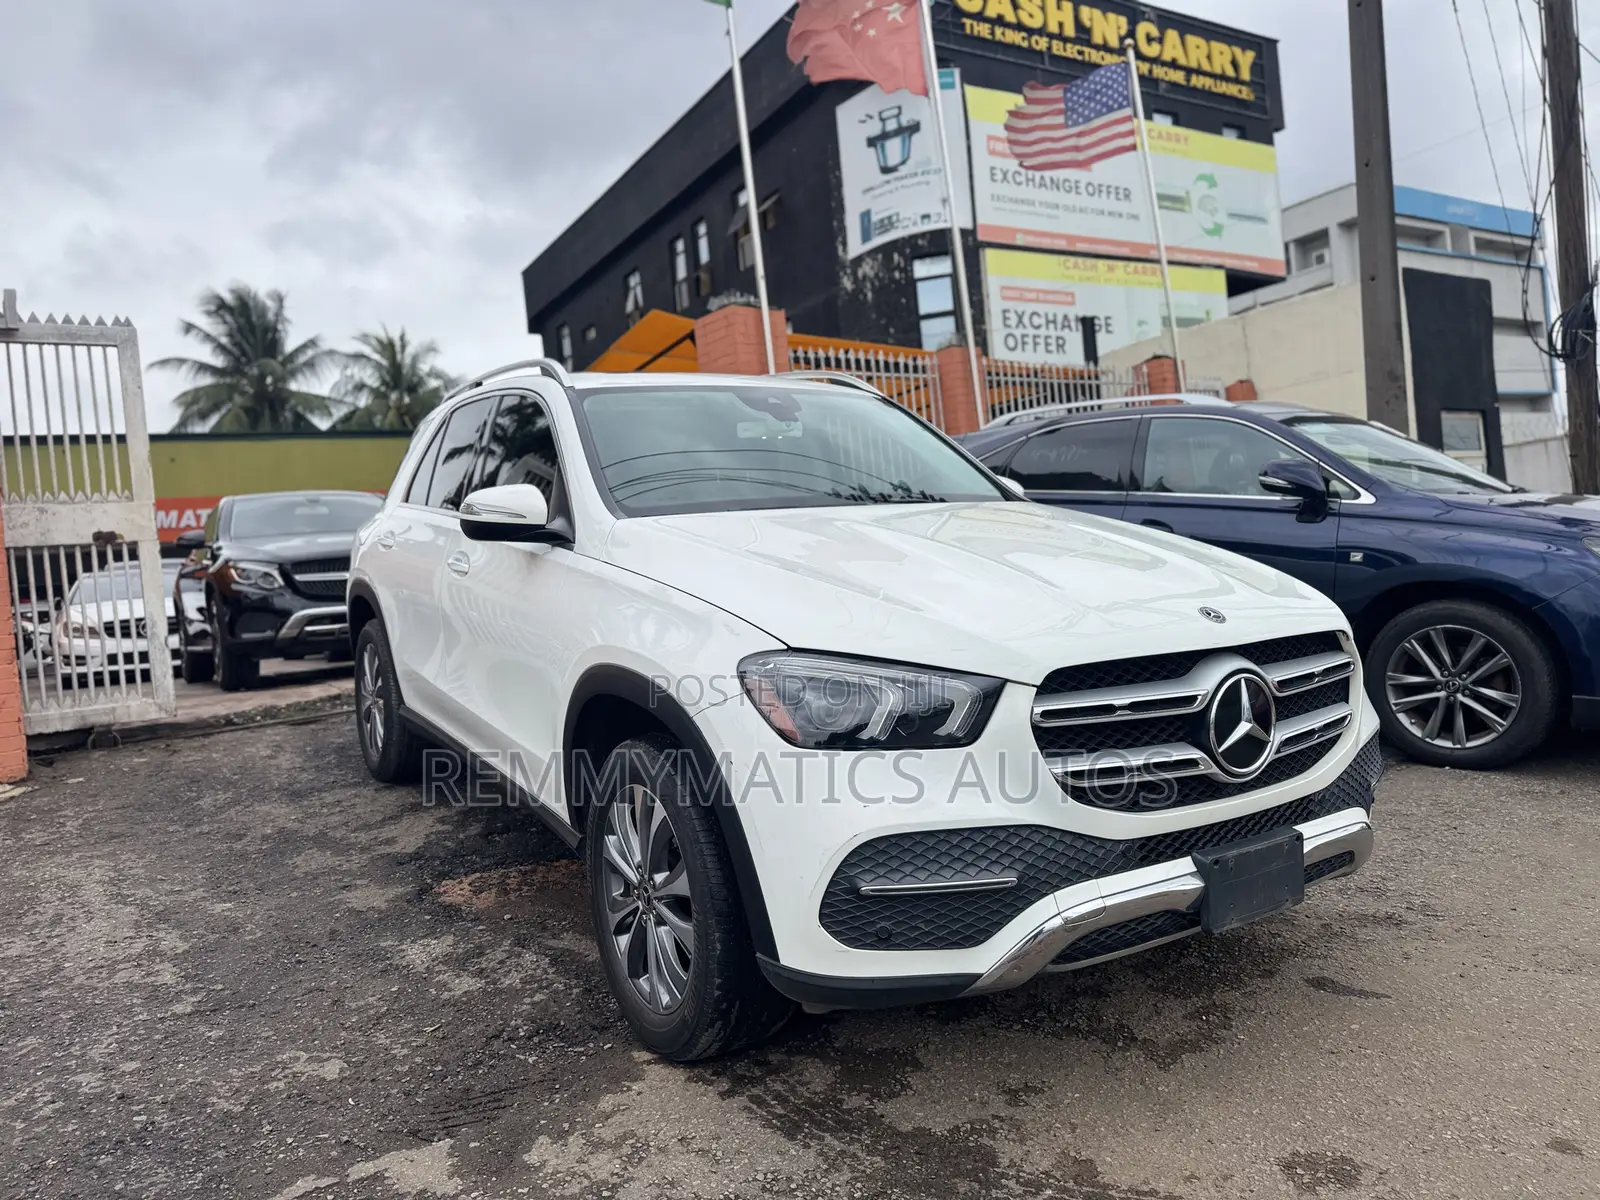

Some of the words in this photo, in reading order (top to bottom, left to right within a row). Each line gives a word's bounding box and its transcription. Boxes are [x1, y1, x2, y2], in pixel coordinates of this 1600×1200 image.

[961, 17, 993, 39] THE
[994, 25, 1029, 47] KING
[1031, 35, 1050, 51] OF
[1051, 39, 1128, 65] ELECTRONI
[1152, 64, 1188, 86] HOME
[1135, 20, 1256, 81] CARRY
[990, 165, 1083, 196] EXCHANGE
[1085, 181, 1132, 203] OFFER
[1062, 258, 1098, 273] CASH
[1122, 264, 1165, 279] CARR
[1003, 332, 1067, 355] OFFER
